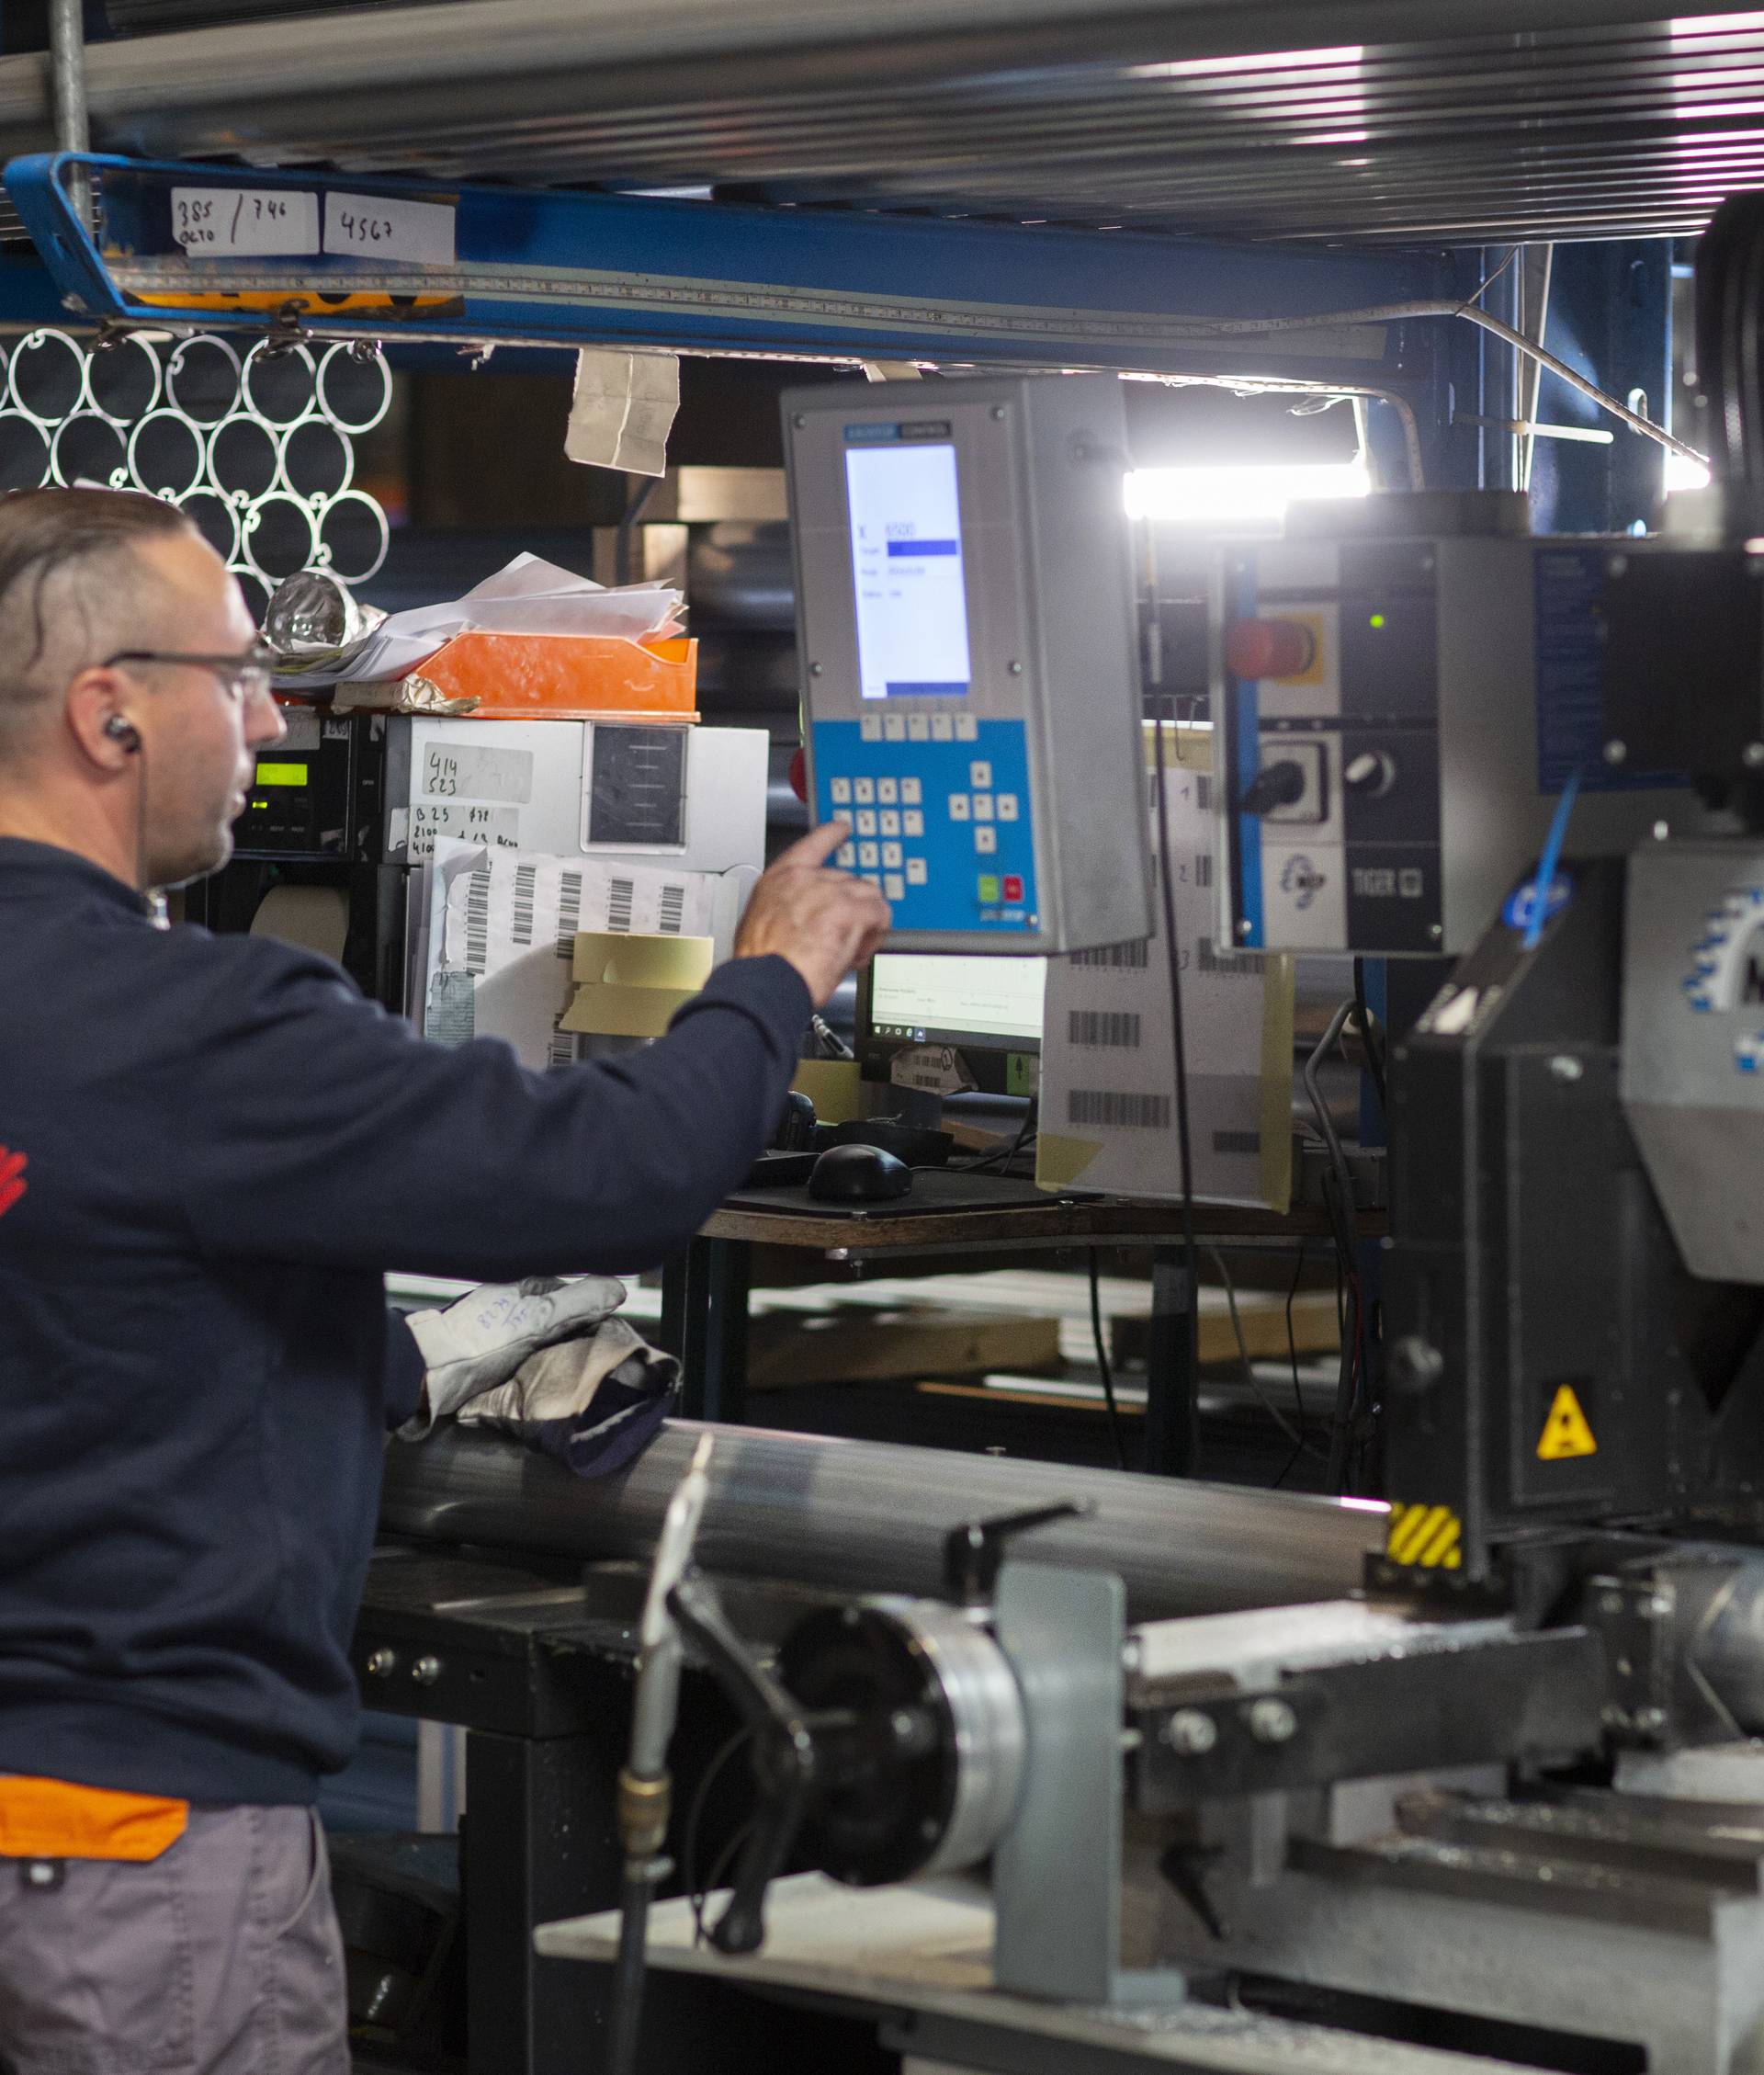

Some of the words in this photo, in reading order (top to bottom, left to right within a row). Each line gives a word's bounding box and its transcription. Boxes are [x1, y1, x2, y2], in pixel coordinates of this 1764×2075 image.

[178, 200, 212, 227] 385
[254, 198, 286, 220] 746
[341, 211, 392, 241] 4567
[430, 753, 457, 777] 414
[429, 777, 456, 796] 523
[414, 825, 438, 838] 2100
